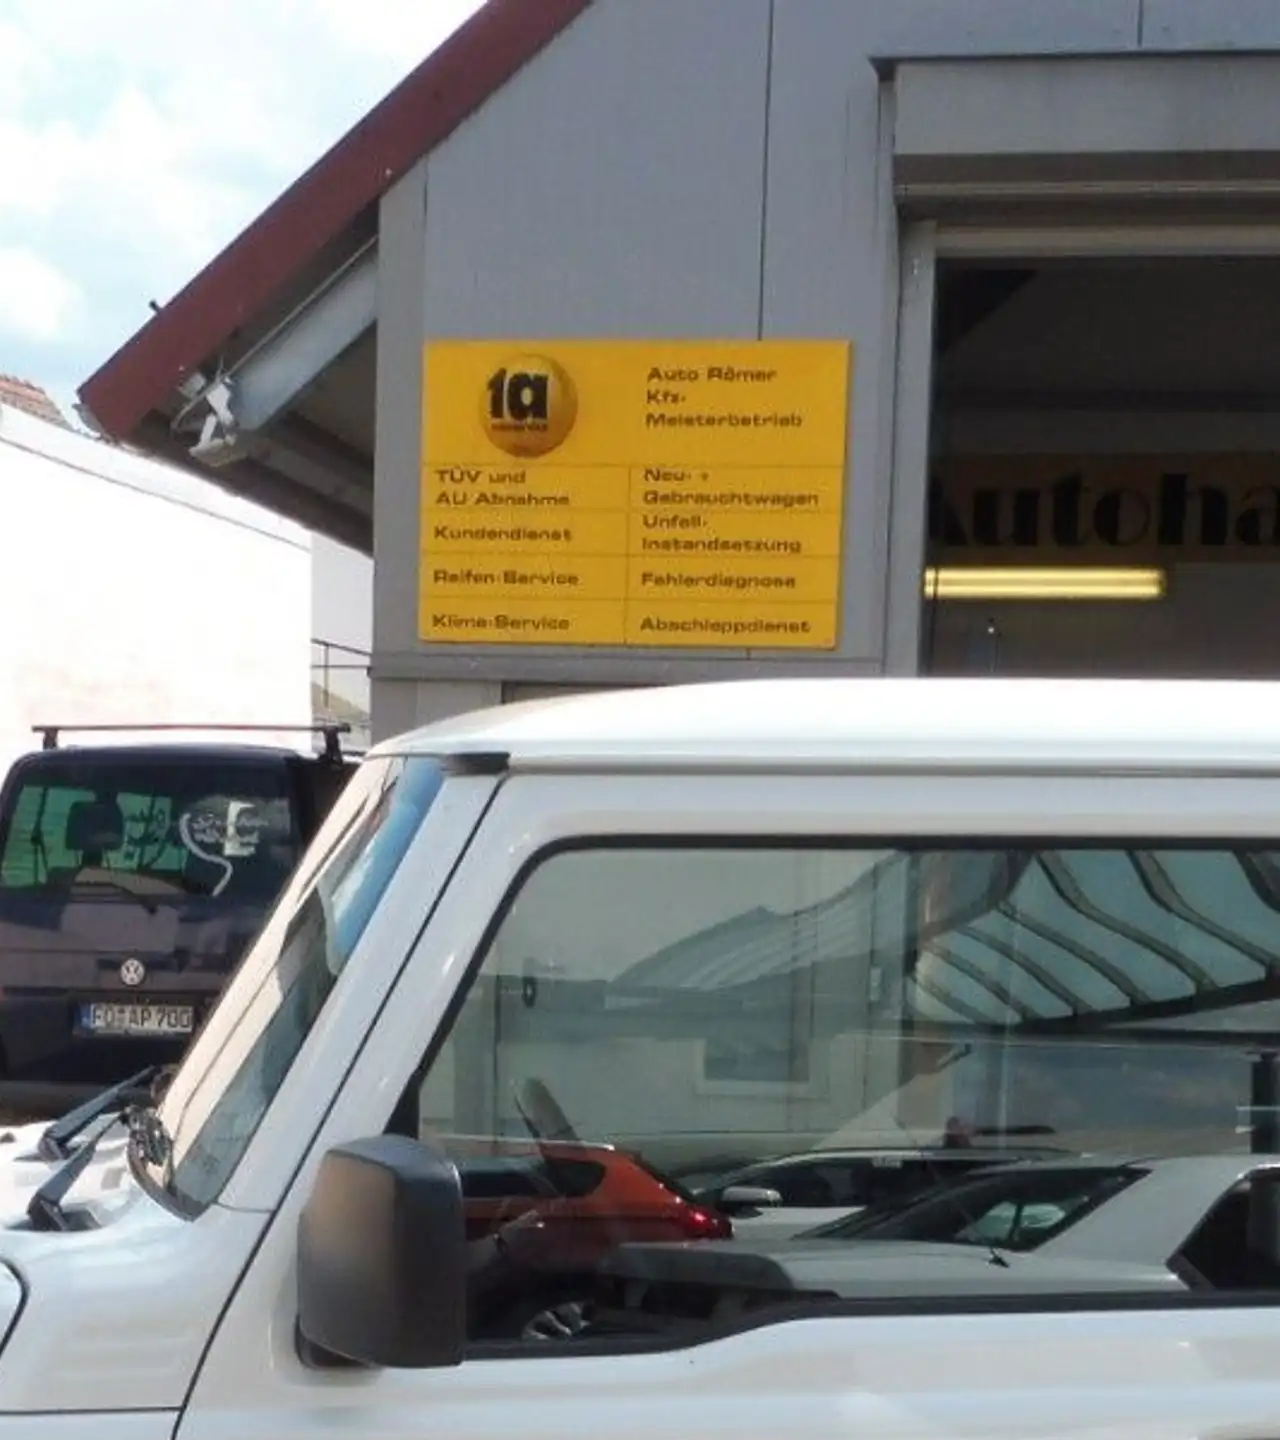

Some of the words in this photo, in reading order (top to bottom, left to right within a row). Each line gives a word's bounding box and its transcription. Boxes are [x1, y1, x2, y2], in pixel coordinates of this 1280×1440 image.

[646, 366, 699, 382] Auto
[706, 366, 778, 382] Römer
[486, 367, 549, 421] 1a
[645, 412, 803, 429] Meisterbetrieb
[435, 467, 483, 484] TÜV
[488, 470, 526, 484] und
[644, 467, 692, 482] Neu-
[474, 491, 570, 506] Abnahme
[642, 489, 819, 508] Gebrauchtwagen
[433, 524, 572, 542] Kundendienst
[641, 537, 802, 555] Instandsetzung
[641, 572, 796, 589] Fehlerdiagnose
[640, 616, 812, 635] Abschleppdienst
